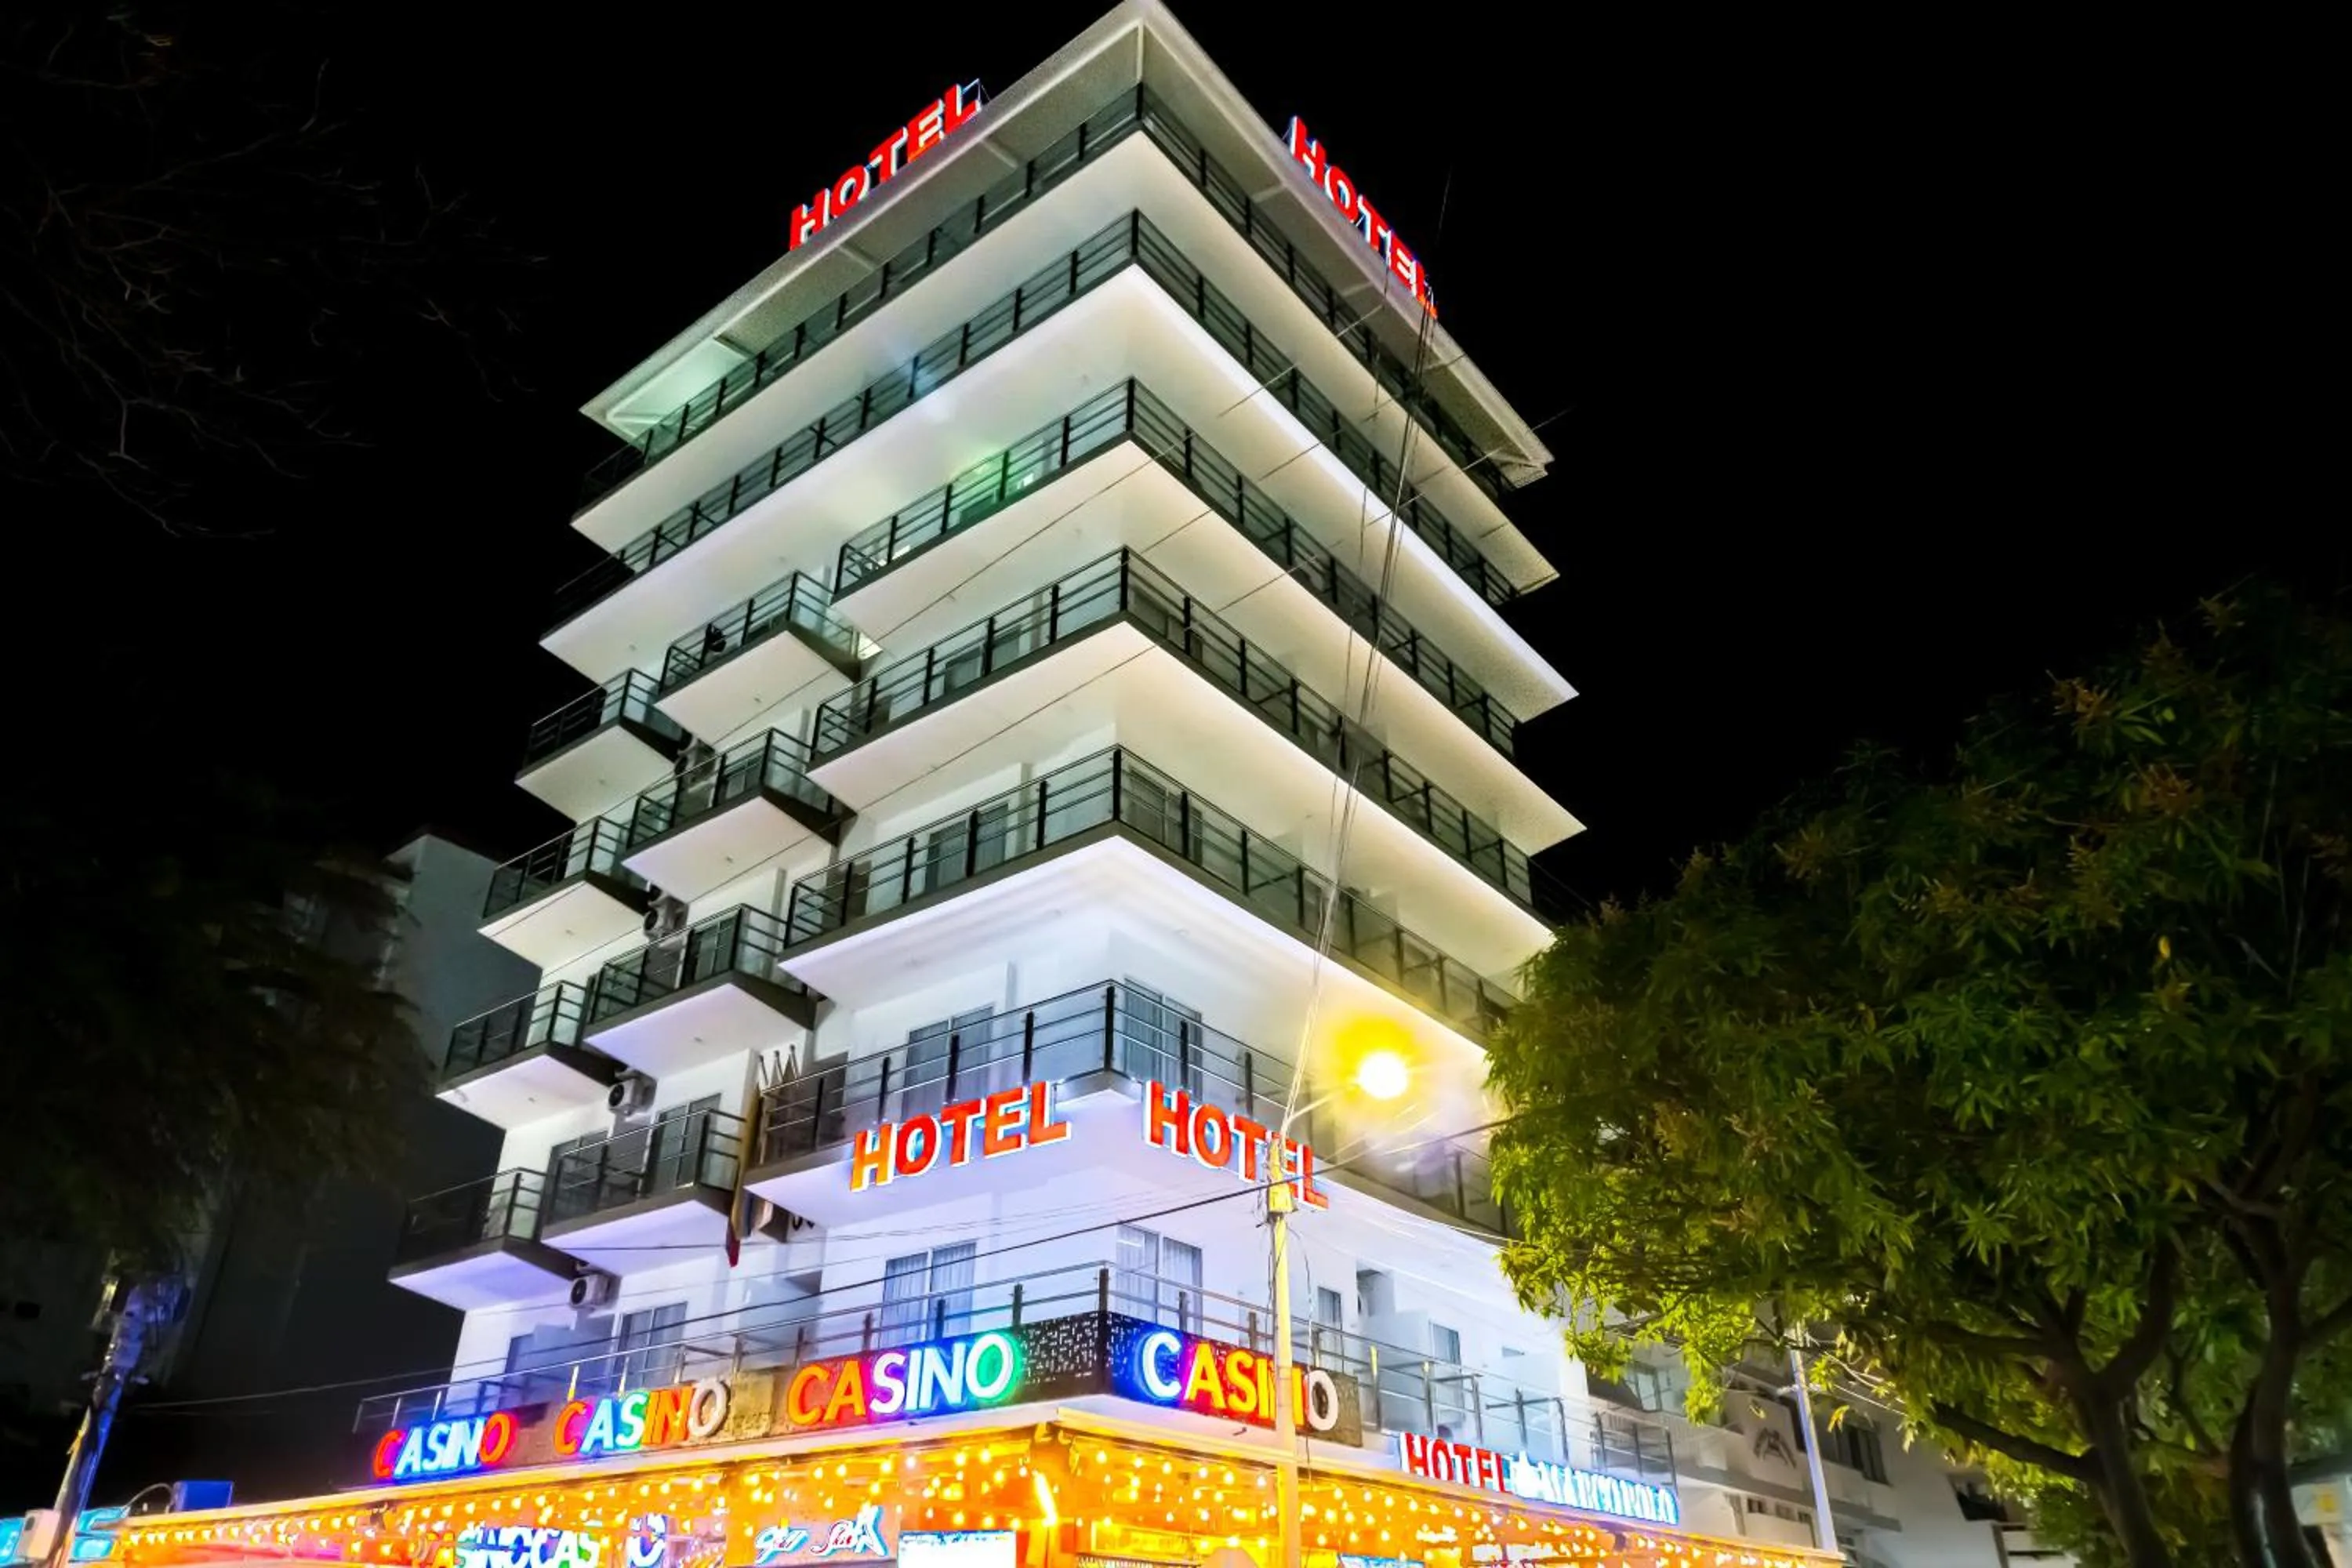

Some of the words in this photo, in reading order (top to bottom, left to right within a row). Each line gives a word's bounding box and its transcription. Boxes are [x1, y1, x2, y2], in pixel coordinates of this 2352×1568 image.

[790, 83, 982, 251] HOTEL
[1291, 115, 1437, 319] HOTEL
[849, 1080, 1071, 1192] HOTEL
[553, 1377, 730, 1457] CASINO
[786, 1332, 1014, 1425] CASINO
[1142, 1331, 1339, 1432] CASINO
[373, 1411, 516, 1479] CASINO
[1400, 1432, 1512, 1494] HOTEL
